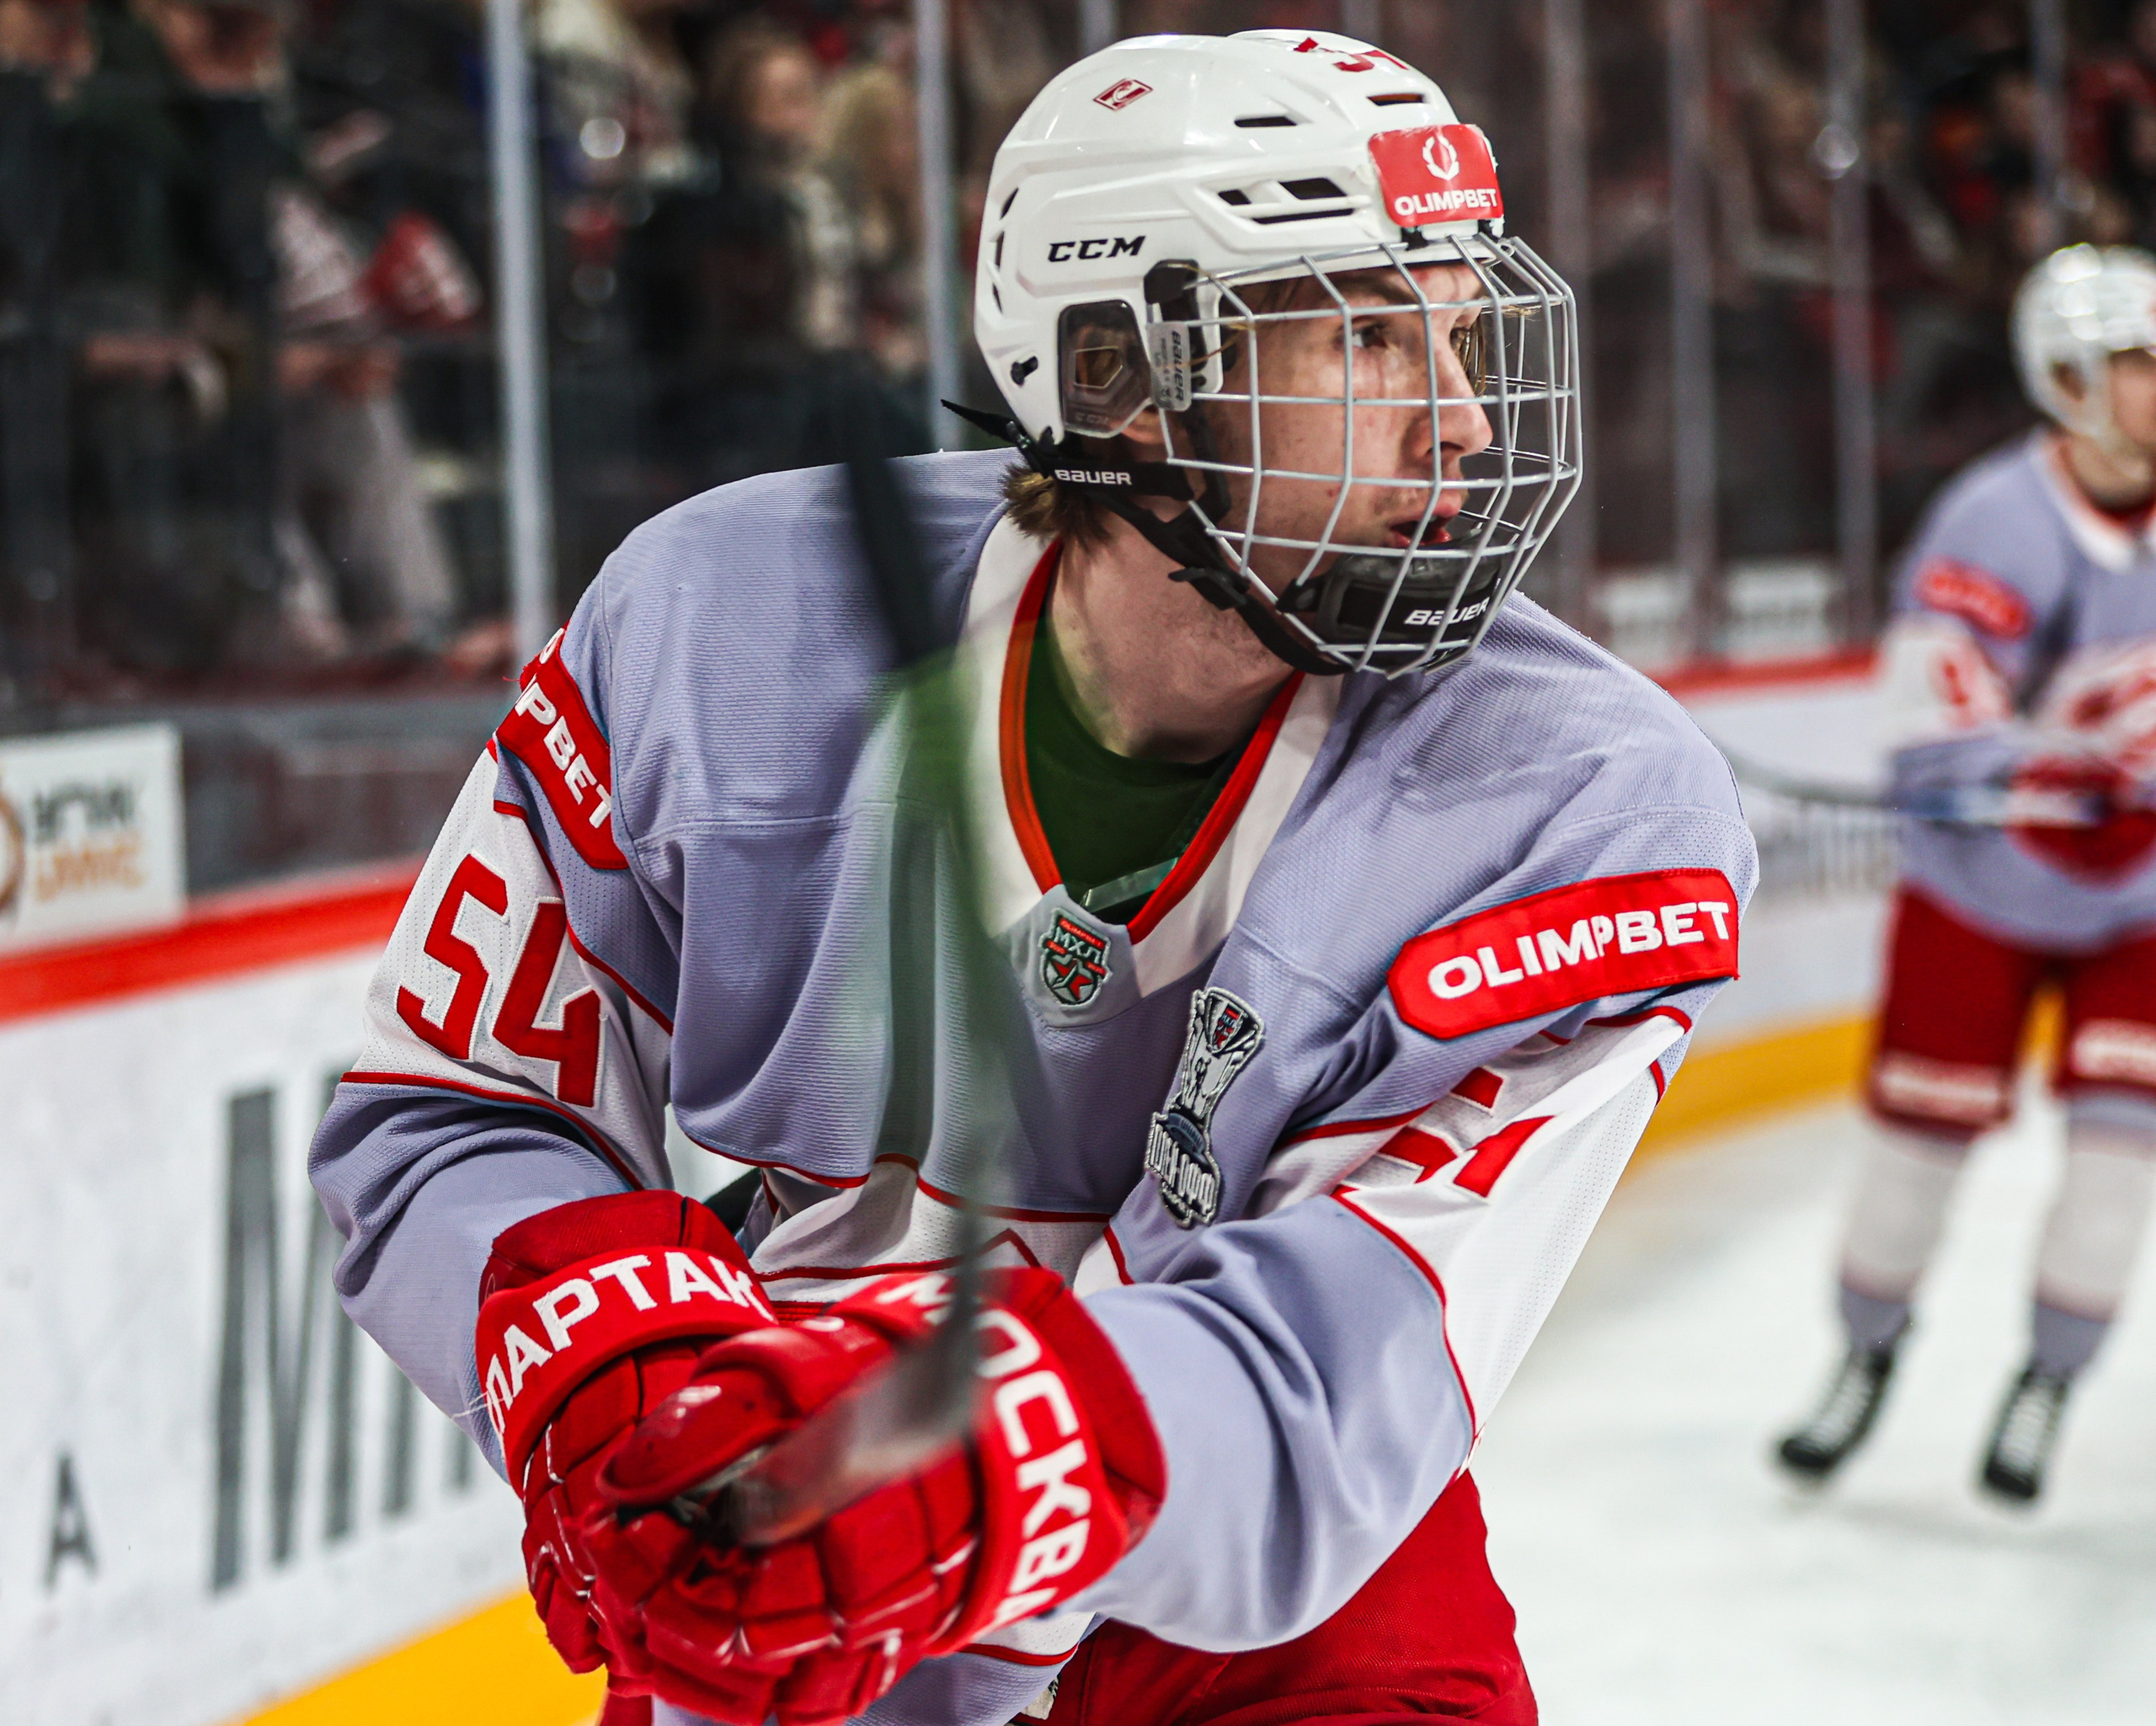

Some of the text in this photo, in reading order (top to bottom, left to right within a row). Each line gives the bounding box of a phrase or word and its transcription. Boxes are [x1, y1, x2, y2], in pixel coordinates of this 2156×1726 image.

[1394, 188, 1497, 216] OLIMPBET
[1048, 235, 1146, 262] CCM
[1054, 469, 1133, 485] BAUER
[1403, 596, 1491, 627] BAUER
[1427, 900, 1731, 1001] OLIMPBET
[395, 852, 605, 1109] 54
